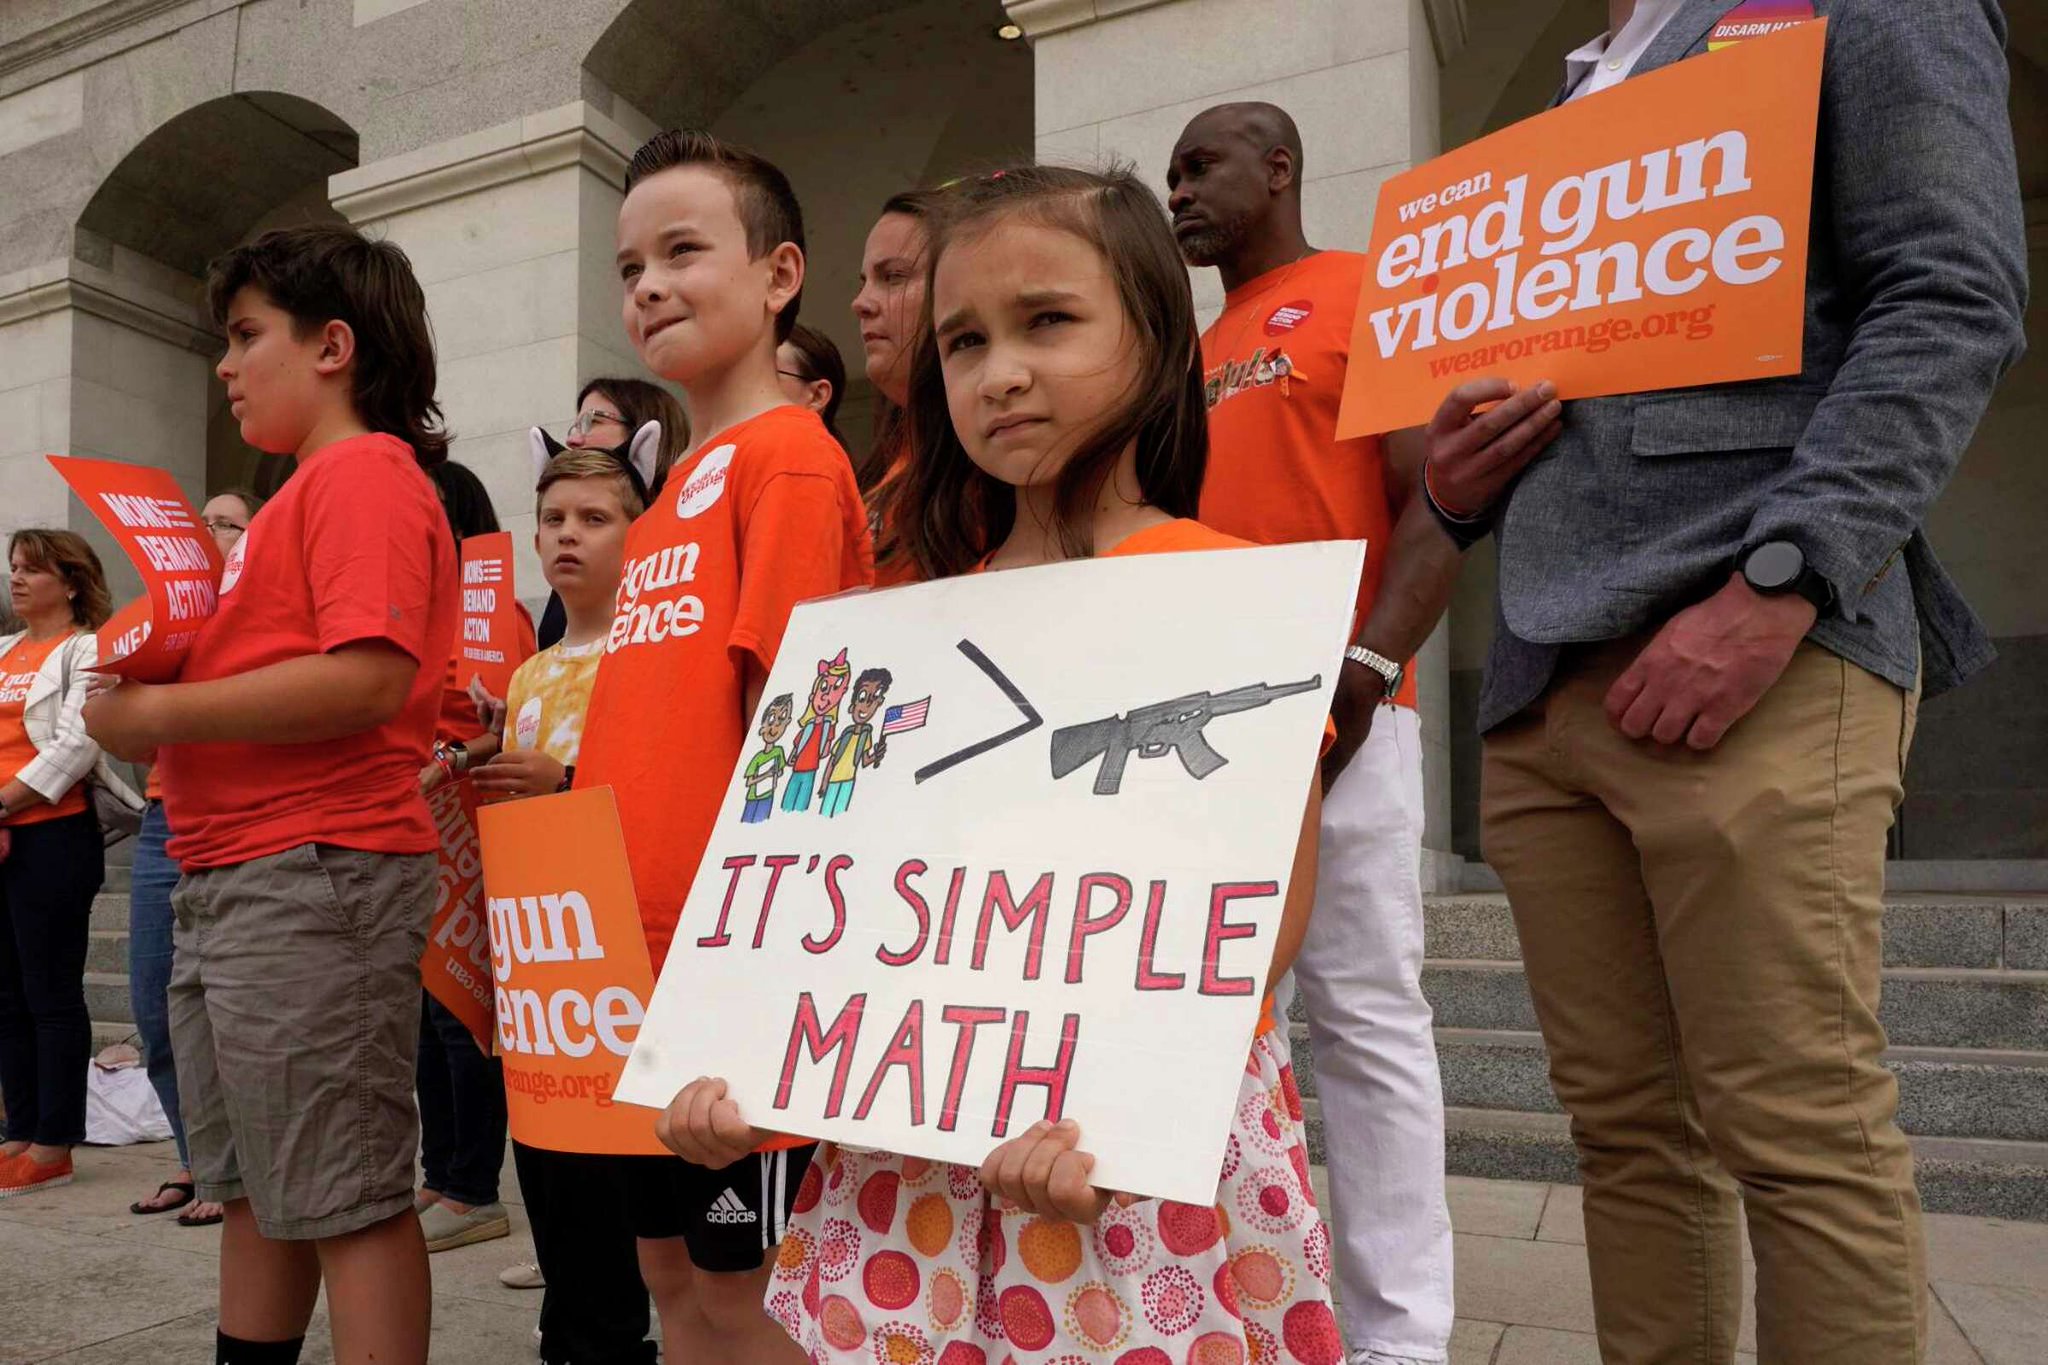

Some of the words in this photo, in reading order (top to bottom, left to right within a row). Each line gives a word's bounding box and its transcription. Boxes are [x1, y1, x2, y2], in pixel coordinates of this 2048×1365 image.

[1715, 23, 1771, 37] DISARM
[1376, 173, 1529, 289] end
[1539, 130, 1752, 256] gun
[1399, 193, 1437, 223] we
[1440, 171, 1492, 206] can
[1369, 214, 1785, 359] violence
[1429, 304, 1716, 379] wearorange.org
[99, 492, 172, 528] MOMS
[134, 535, 211, 571] DEMAND
[165, 579, 216, 621] ACTION
[697, 853, 855, 955] IT'S
[875, 859, 1279, 996] SIMPLE
[446, 956, 475, 992] can
[772, 991, 1081, 1138] MATH
[706, 1209, 757, 1224] adidas
